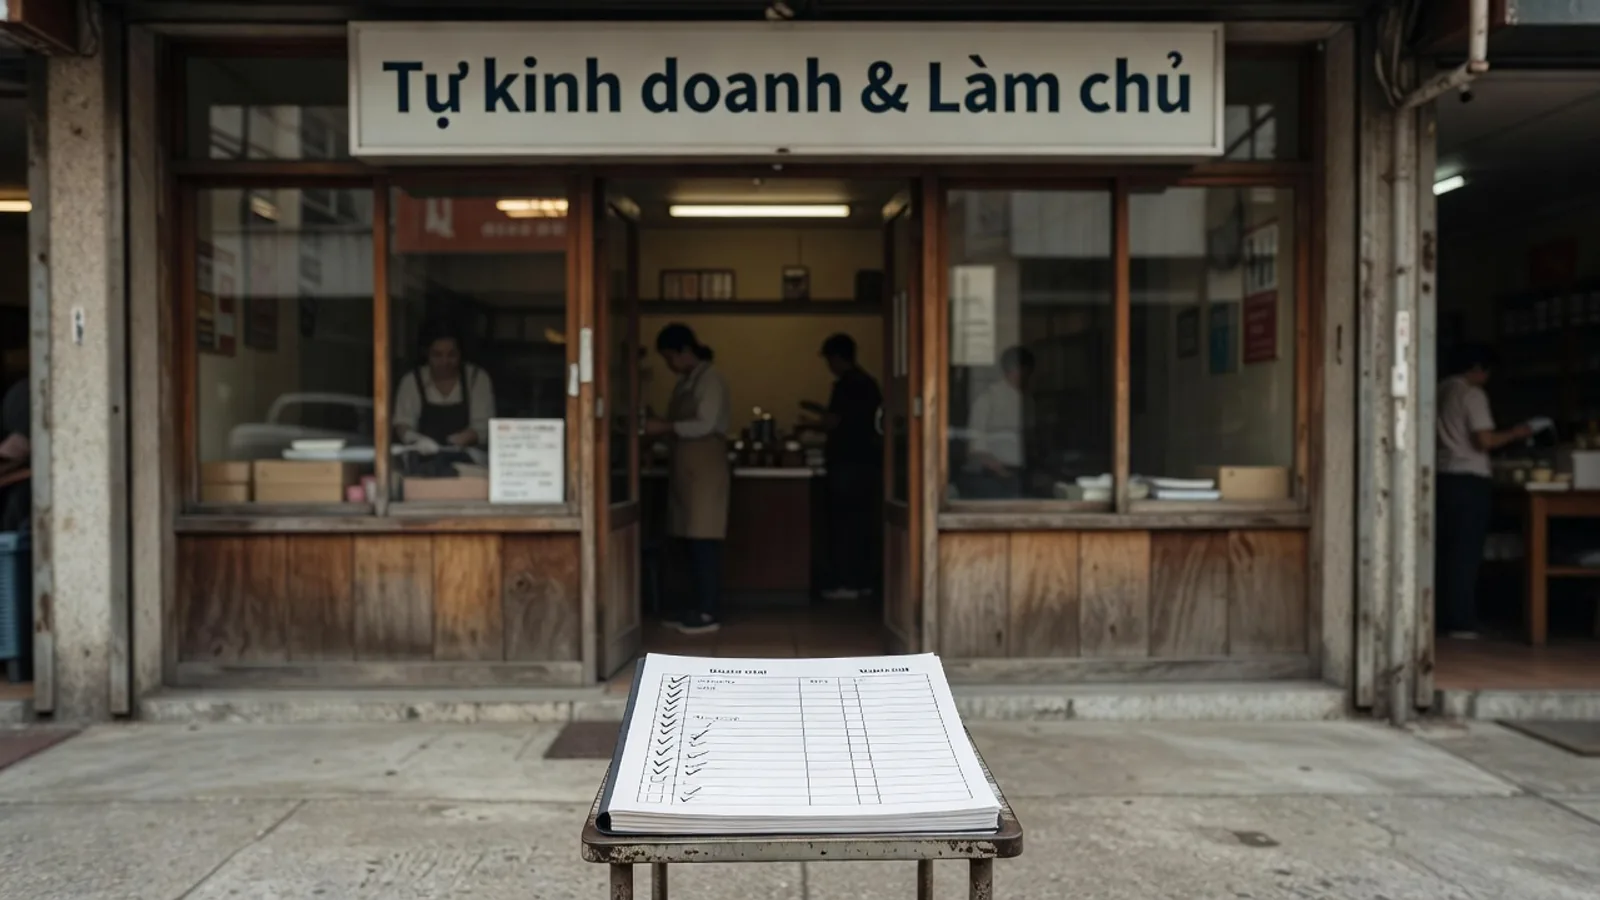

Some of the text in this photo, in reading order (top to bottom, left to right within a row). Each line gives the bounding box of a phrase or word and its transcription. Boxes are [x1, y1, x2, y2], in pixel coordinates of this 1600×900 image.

[382, 50, 1190, 129] Tự kinh doanh & Làm chủ
